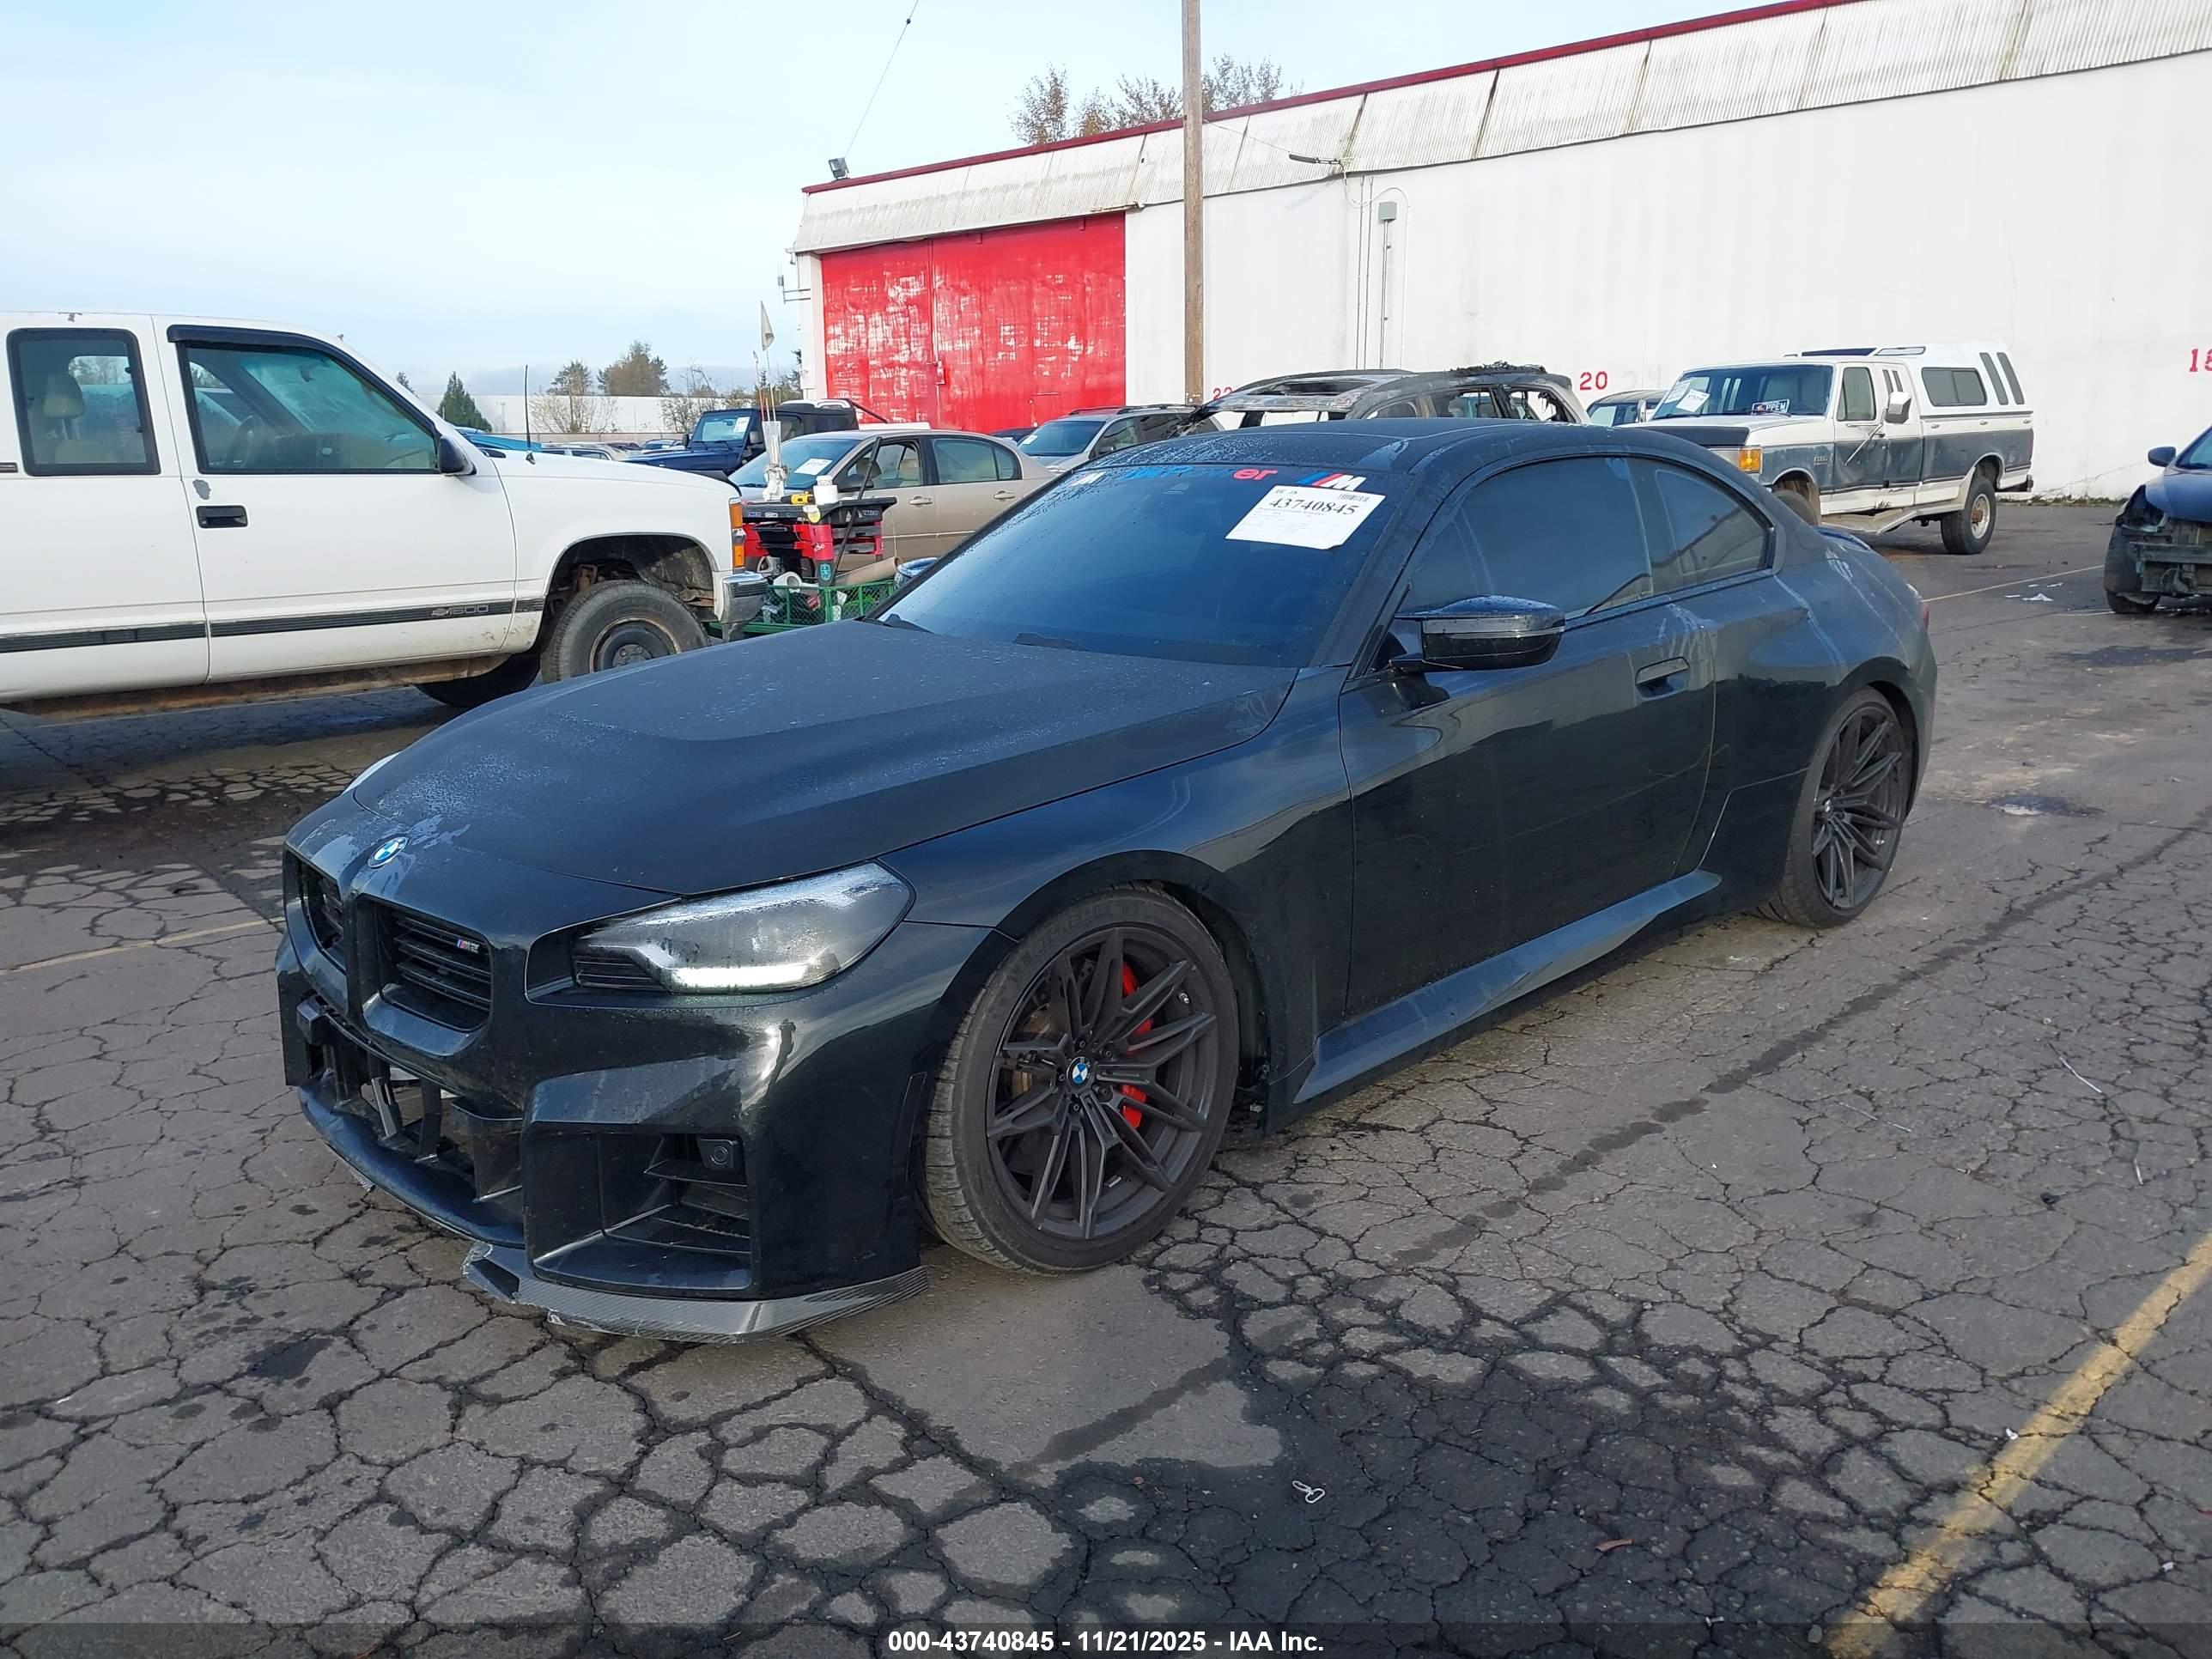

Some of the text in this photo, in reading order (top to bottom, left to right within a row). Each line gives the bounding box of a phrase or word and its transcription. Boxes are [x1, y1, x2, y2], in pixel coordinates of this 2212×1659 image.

[1580, 371, 1607, 390] 20
[1316, 474, 1367, 492] M
[1269, 497, 1359, 515] 43740845
